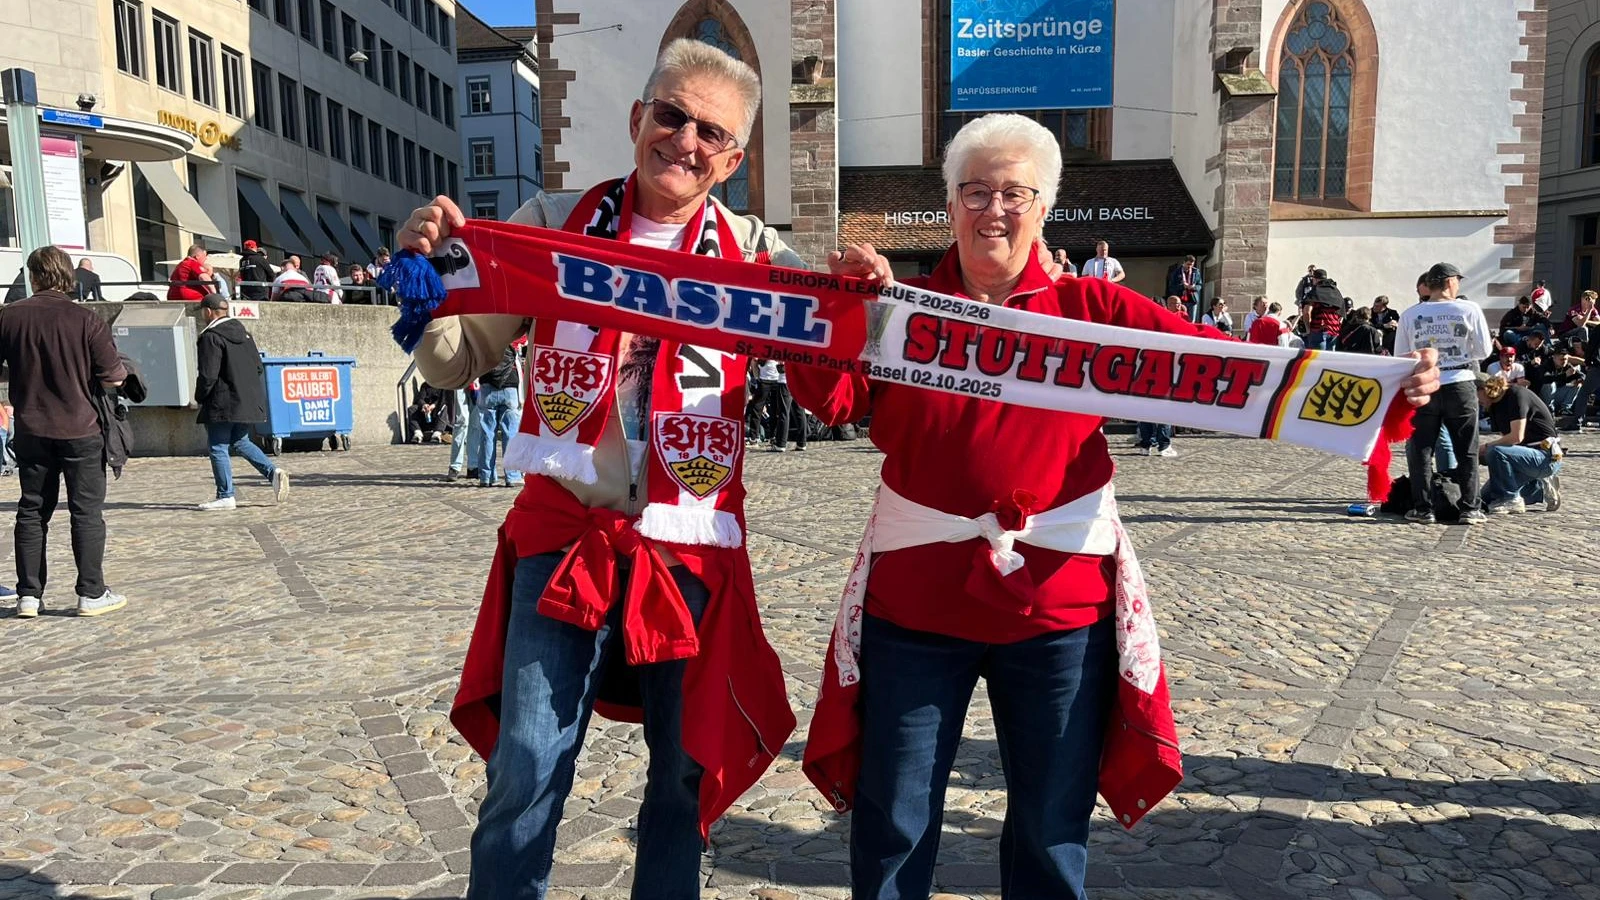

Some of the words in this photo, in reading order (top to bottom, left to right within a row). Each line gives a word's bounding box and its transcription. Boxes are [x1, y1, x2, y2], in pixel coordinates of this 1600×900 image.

[957, 17, 1103, 42] Zeitsprünge
[957, 47, 990, 57] Basler
[993, 46, 1054, 57] Geschichte
[1056, 45, 1066, 55] in
[1069, 44, 1101, 54] Kürze
[957, 86, 1037, 95] BARFÜSSERKIRCHE
[884, 210, 951, 225] HISTORI
[1044, 208, 1092, 222] SEUM
[1099, 207, 1154, 220] BASEL
[552, 253, 832, 348] BASEL
[768, 269, 840, 291] EUROPA
[844, 280, 917, 304] LEAGUE
[919, 294, 990, 320] 2025/26
[902, 311, 1269, 409] STUTTGART
[287, 372, 309, 381] BASEL
[310, 371, 333, 381] BLEIBT
[735, 340, 758, 355] St.
[761, 344, 813, 365] Jakob
[817, 352, 857, 373] Park
[861, 360, 907, 382] Basel
[910, 369, 1002, 398] 02.10.2025
[287, 382, 334, 397] SAUBER
[304, 400, 329, 410] DANK
[304, 409, 330, 421] DIR!
